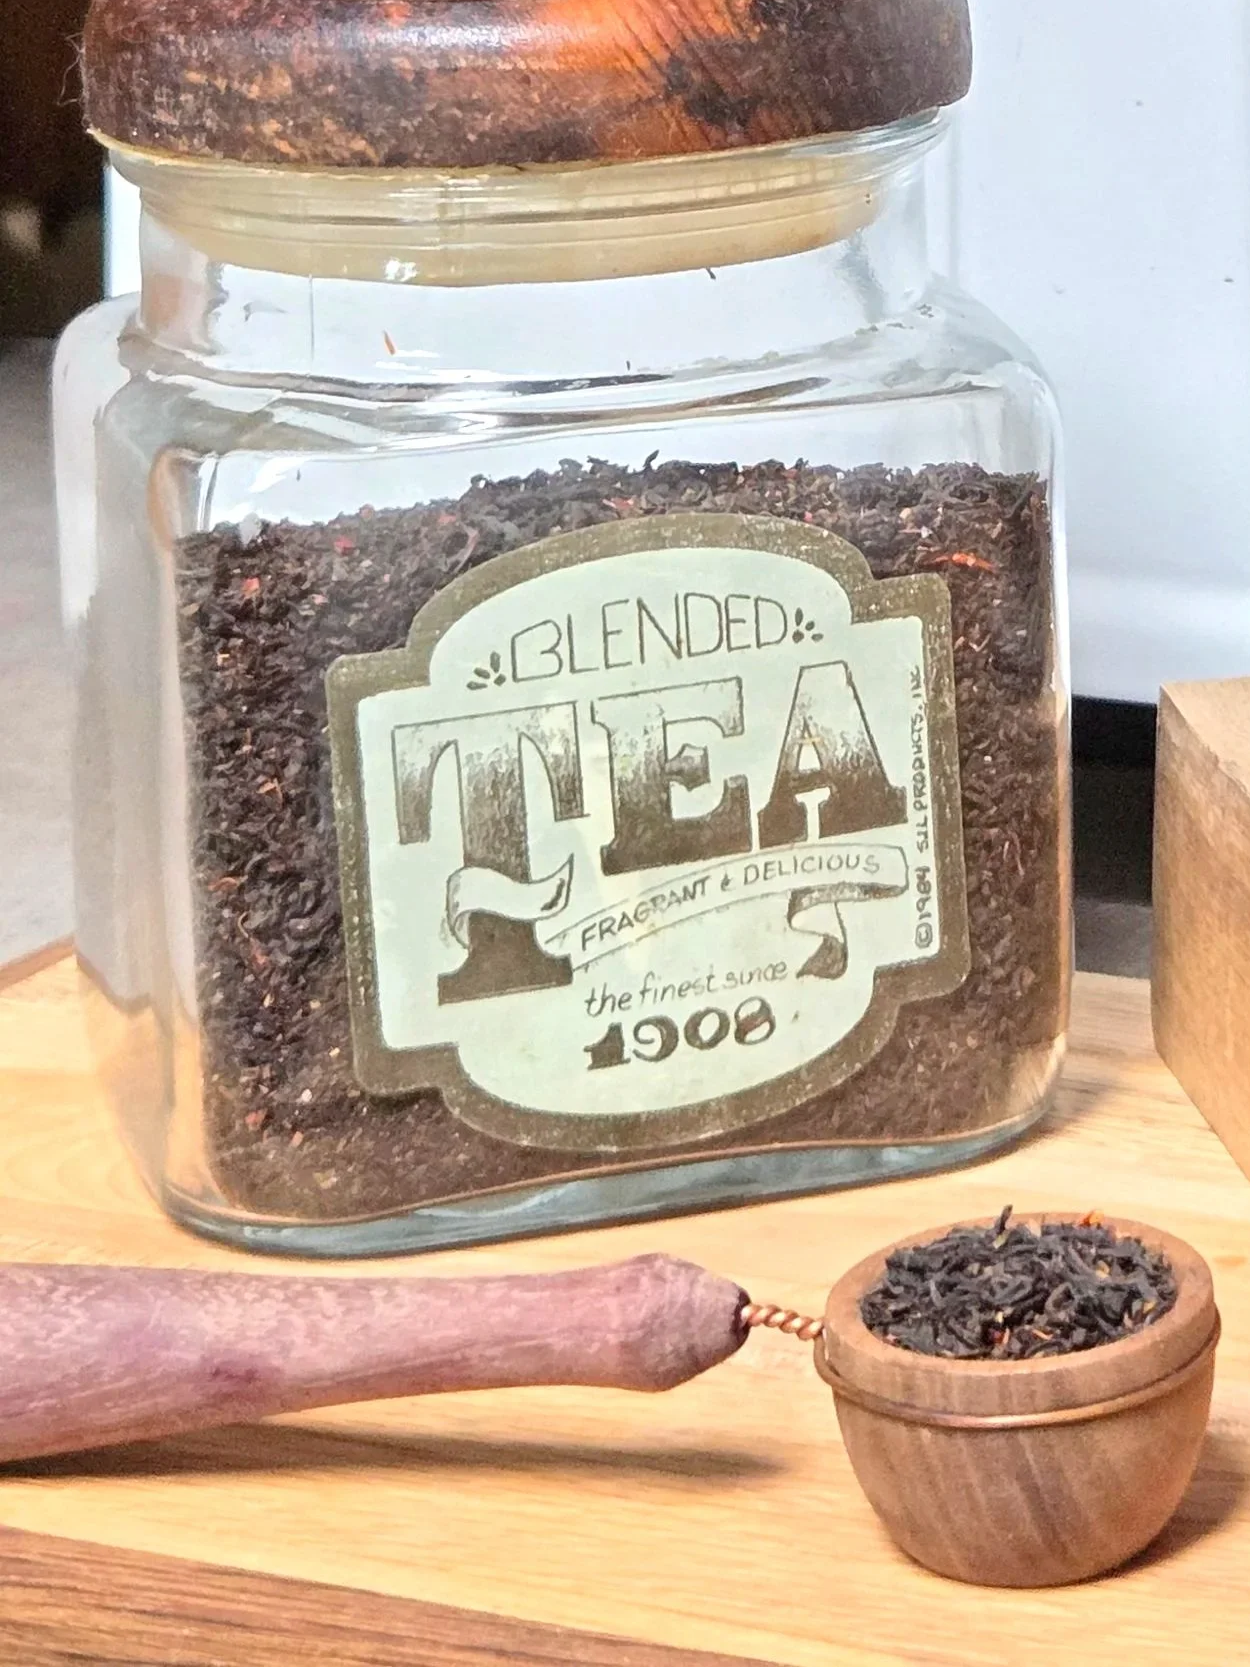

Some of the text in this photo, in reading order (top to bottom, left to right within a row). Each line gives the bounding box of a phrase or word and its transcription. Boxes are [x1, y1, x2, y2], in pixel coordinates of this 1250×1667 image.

[510, 591, 788, 683] BLENDED
[391, 659, 909, 1006] TEA
[581, 875, 711, 951] FRAGRANT
[743, 853, 881, 886] DELICIOUS
[583, 995, 777, 1071] 1908
[584, 960, 788, 1018] the finest since
